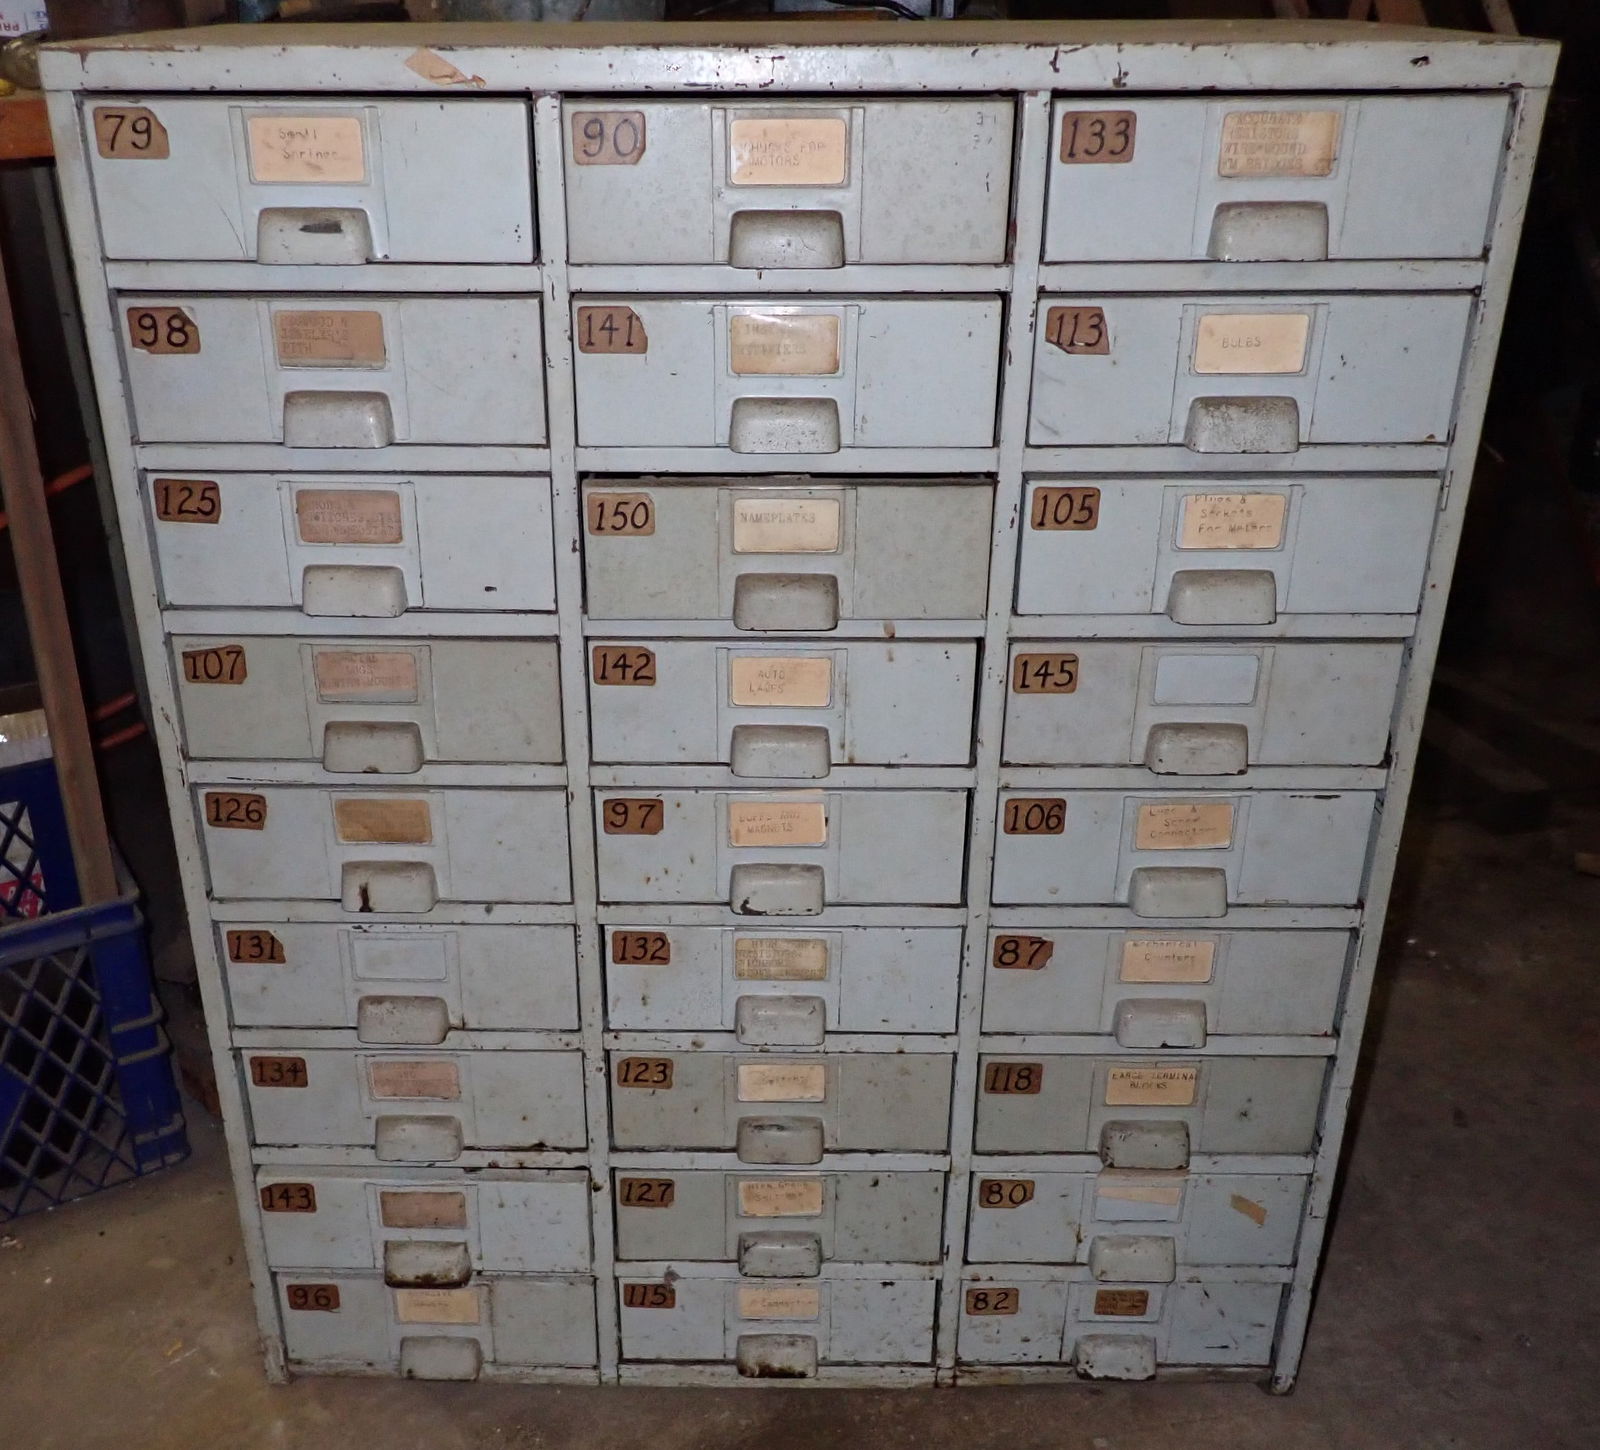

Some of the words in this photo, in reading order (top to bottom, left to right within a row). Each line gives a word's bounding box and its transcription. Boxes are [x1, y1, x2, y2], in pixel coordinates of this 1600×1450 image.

[105, 114, 153, 152] 79
[583, 117, 639, 157] 90
[1067, 117, 1130, 158] 133
[138, 313, 190, 347] 98
[585, 313, 637, 348] 141
[1056, 312, 1104, 347] 113
[1222, 336, 1262, 348] BULBS
[163, 486, 216, 516] 125
[1037, 493, 1096, 526] 105
[596, 501, 650, 530] 150
[741, 512, 816, 525] NAMEPLATES
[187, 650, 243, 680] 107
[601, 652, 655, 681] 142
[1020, 659, 1077, 688] 145
[213, 798, 264, 822] 126
[610, 802, 657, 828] 97
[1010, 804, 1063, 831] 106
[233, 934, 277, 960] 131
[620, 935, 669, 961] 132
[998, 939, 1048, 967] 87
[257, 1061, 304, 1083] 134
[622, 1062, 668, 1083] 123
[989, 1067, 1033, 1091] 118
[266, 1187, 313, 1209] 143
[625, 1182, 673, 1203] 127
[986, 1182, 1027, 1205] 80
[293, 1287, 332, 1307] 96
[630, 1285, 667, 1306] 115
[973, 1292, 1009, 1311] 82
